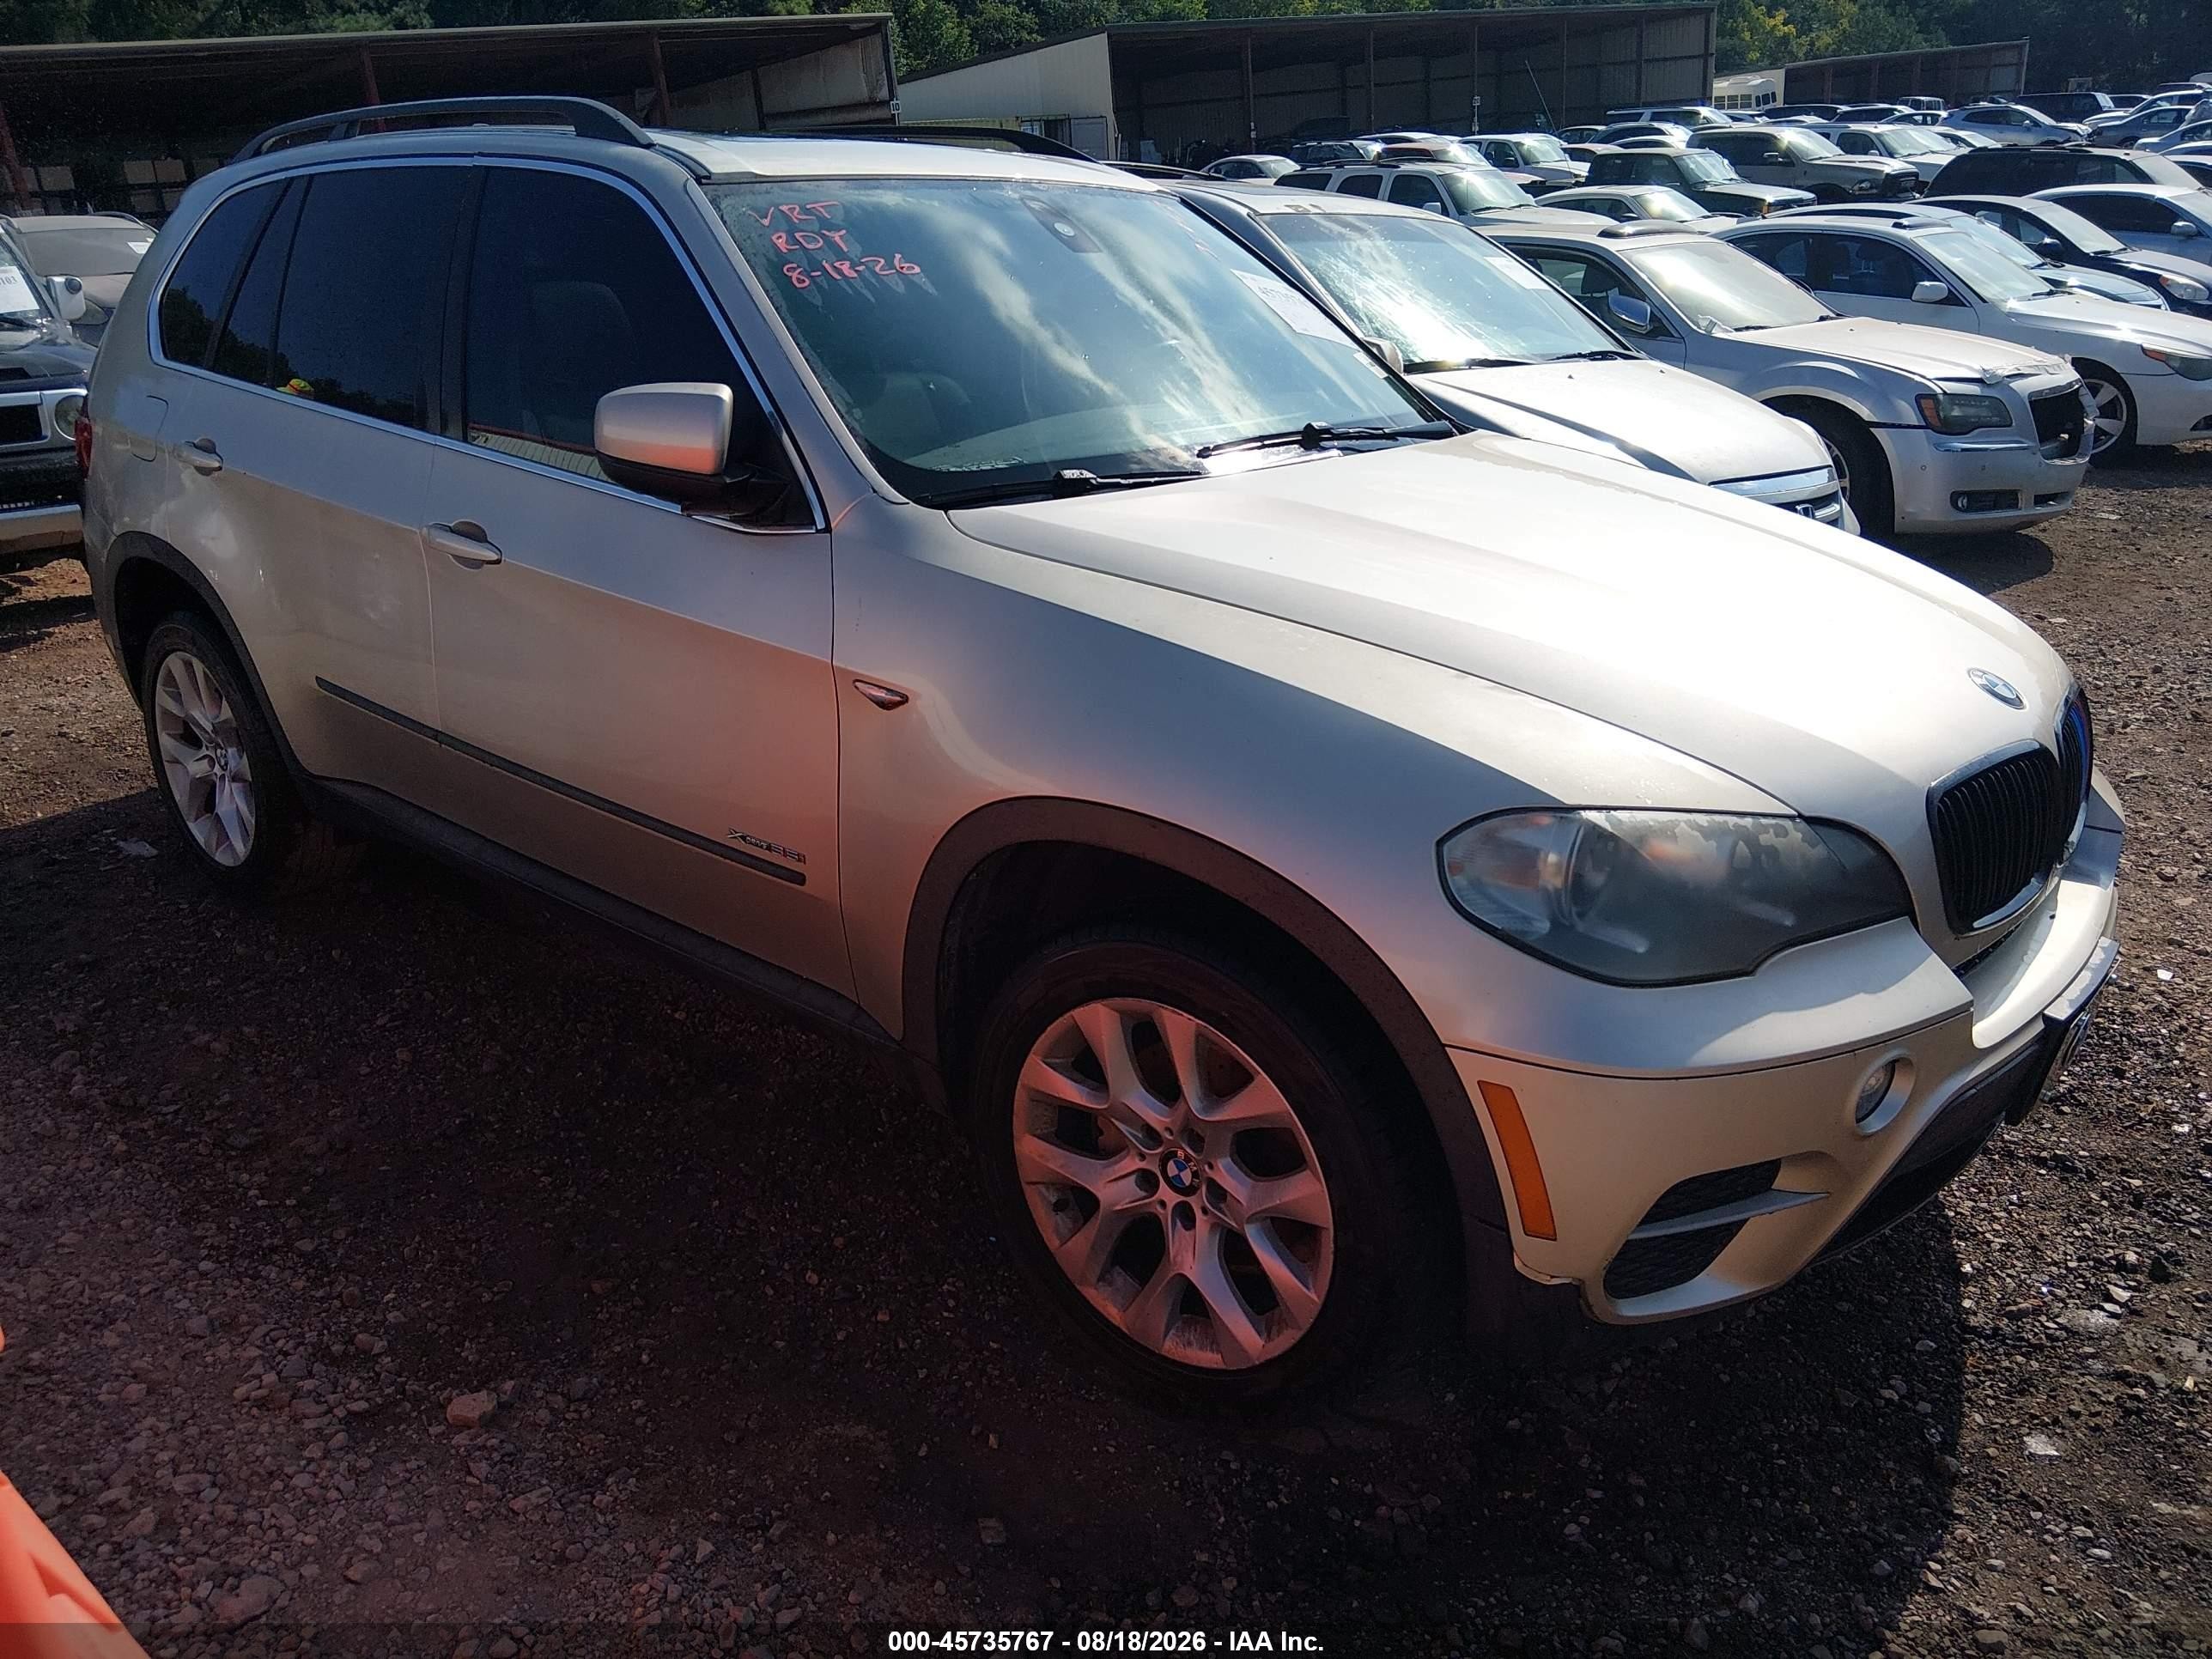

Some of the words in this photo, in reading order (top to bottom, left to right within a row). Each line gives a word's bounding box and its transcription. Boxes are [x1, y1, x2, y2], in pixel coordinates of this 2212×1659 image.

[748, 201, 840, 227] VRT
[771, 228, 848, 253] RDY
[782, 252, 921, 289] 8-18-26
